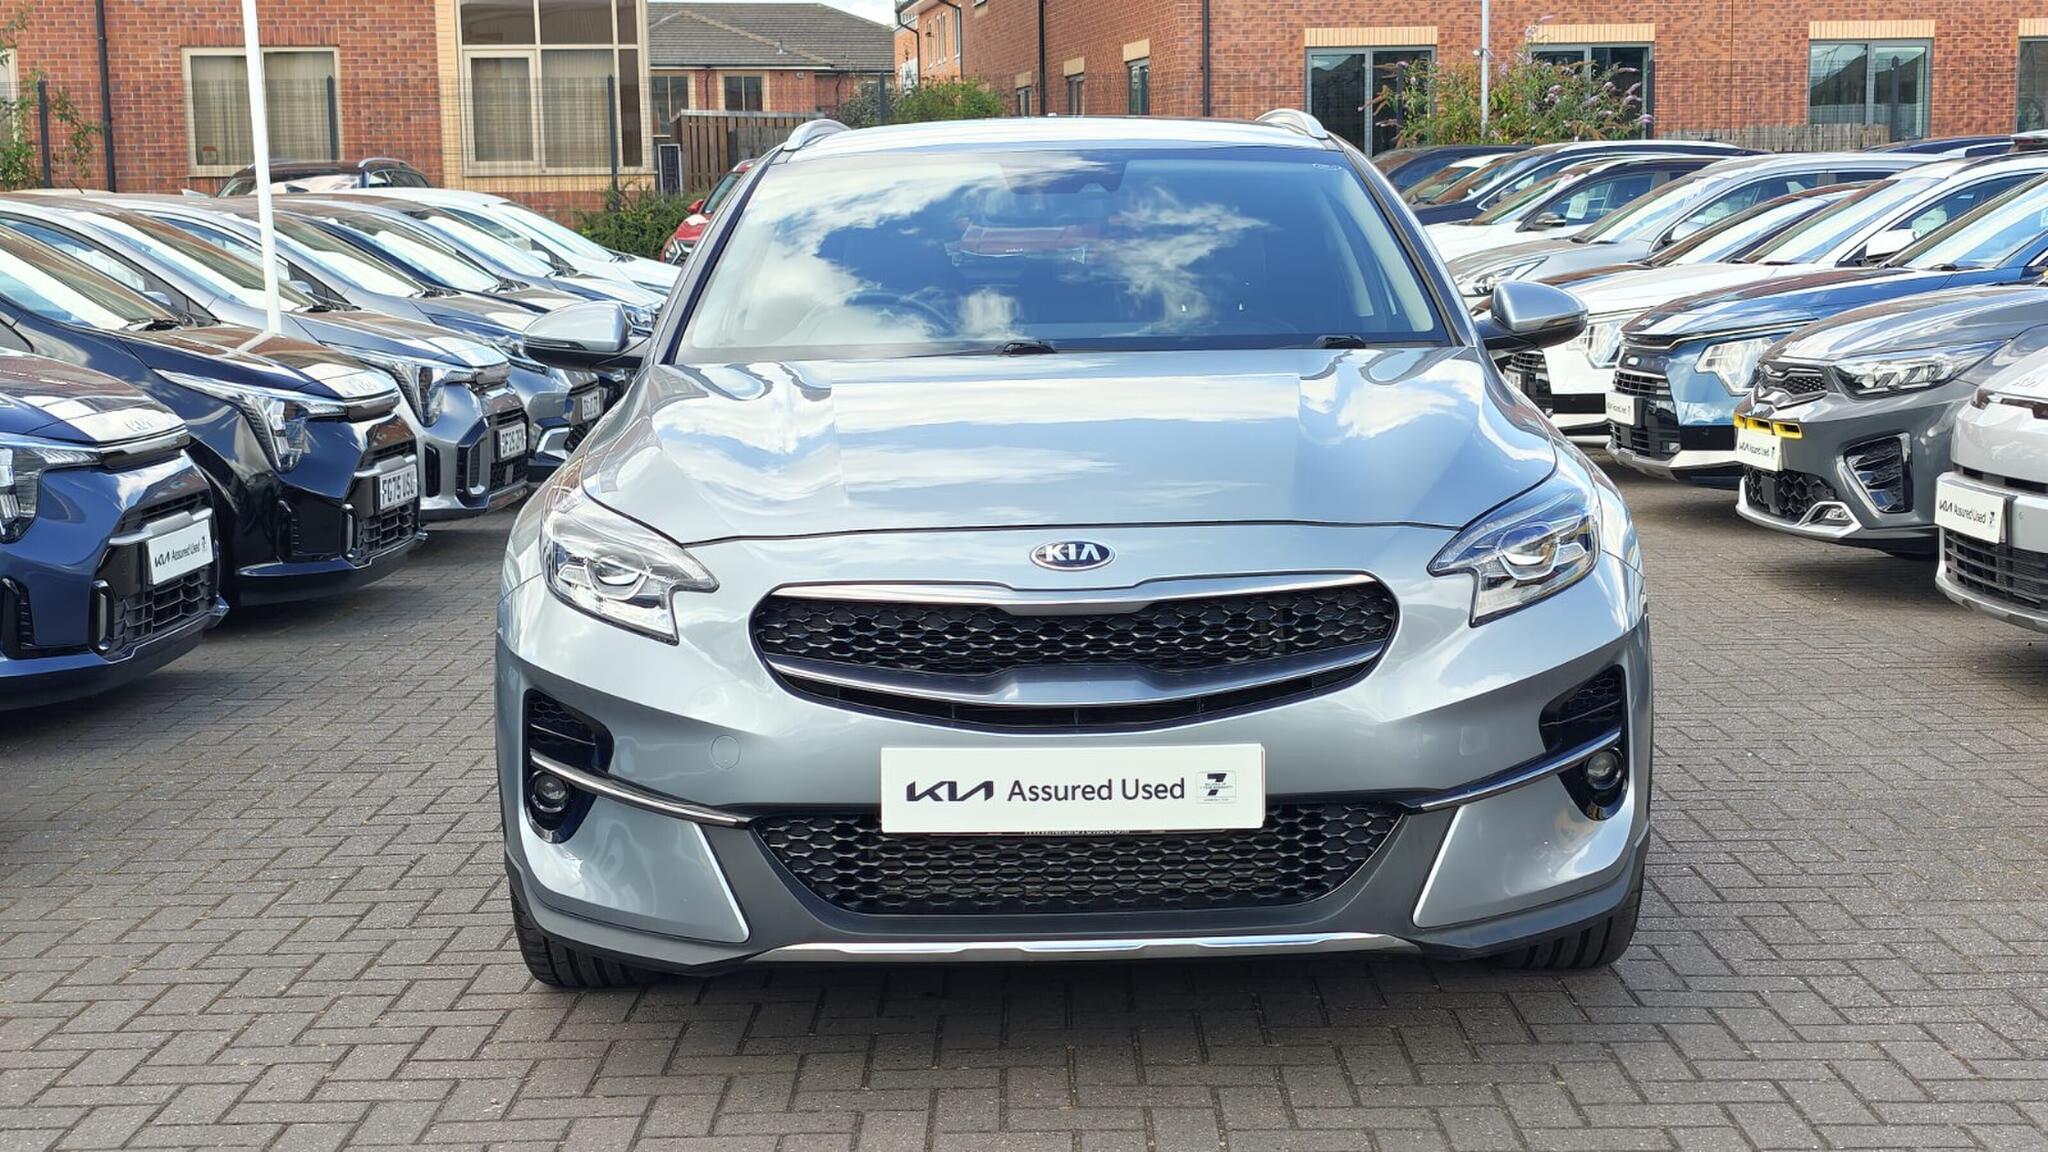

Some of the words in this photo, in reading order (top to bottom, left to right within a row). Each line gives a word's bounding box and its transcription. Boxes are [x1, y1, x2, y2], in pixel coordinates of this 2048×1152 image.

[382, 474, 401, 505] FG75
[1939, 499, 1953, 512] KIA
[155, 551, 170, 567] KIA
[1045, 543, 1101, 561] KIA
[906, 780, 993, 801] KIA
[1007, 778, 1112, 801] Assured
[1121, 777, 1185, 801] Used
